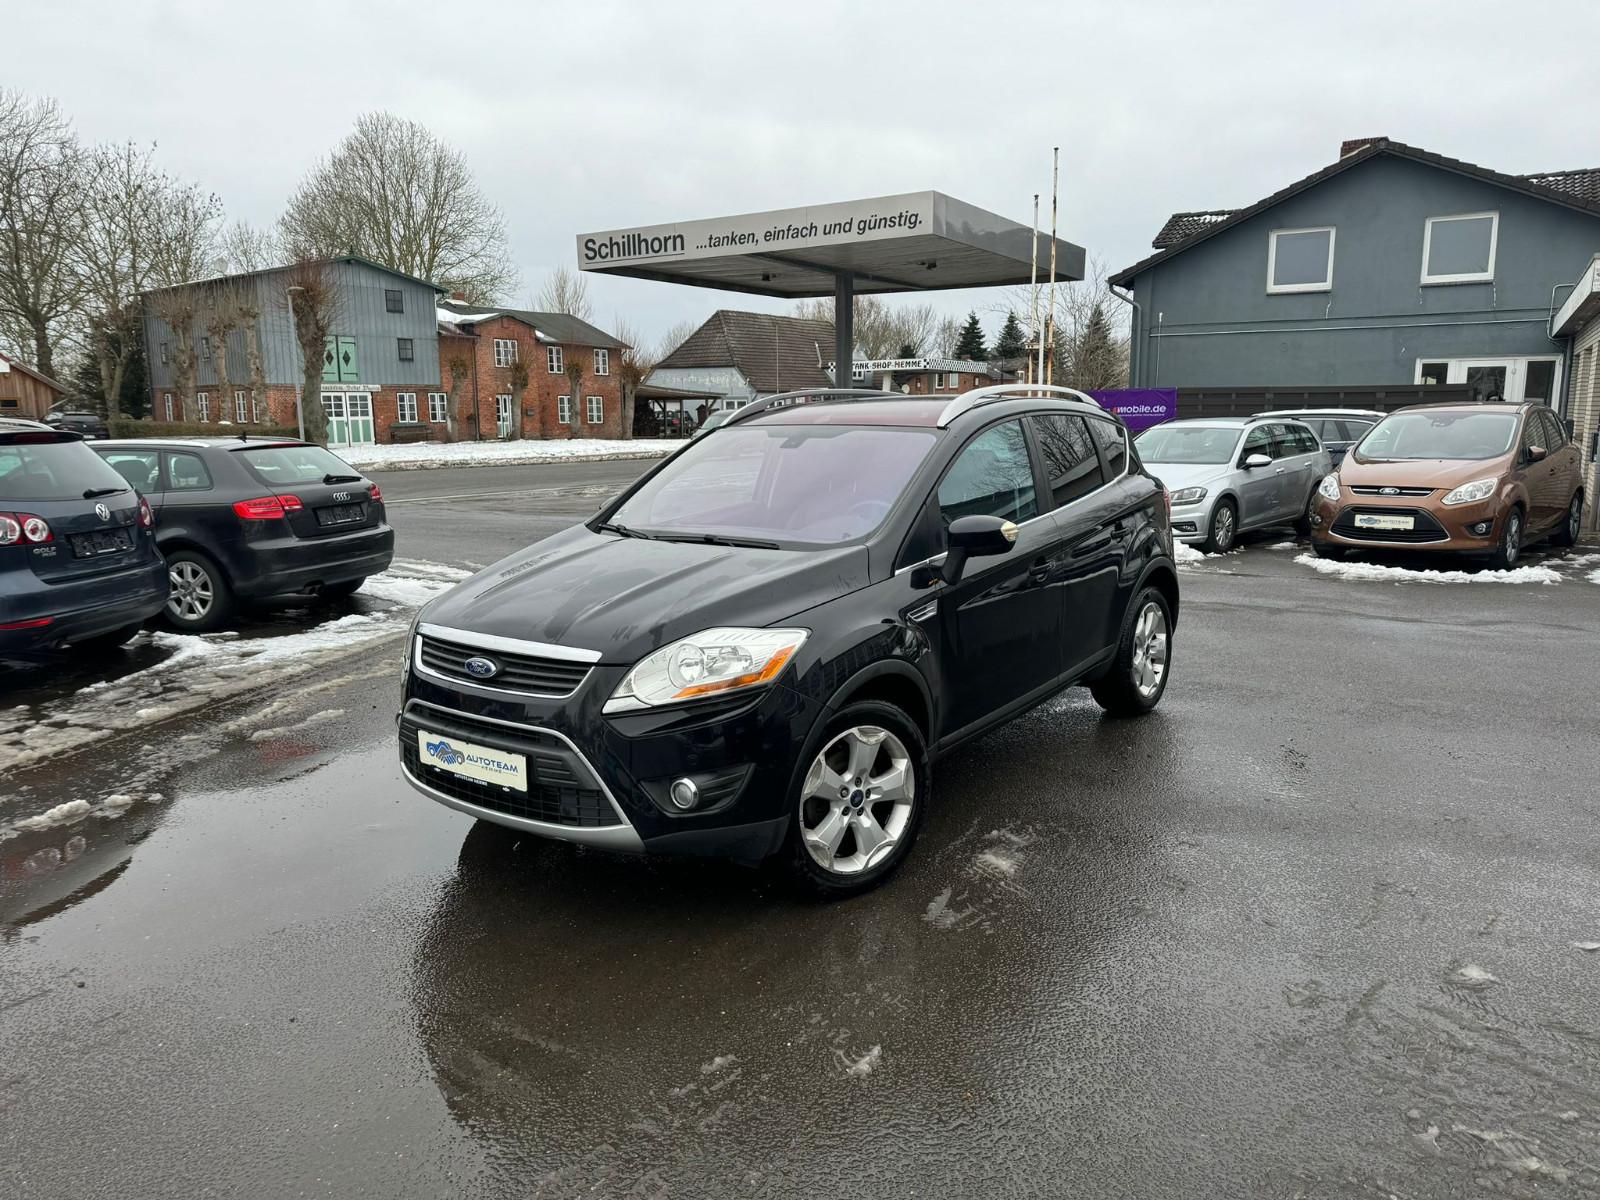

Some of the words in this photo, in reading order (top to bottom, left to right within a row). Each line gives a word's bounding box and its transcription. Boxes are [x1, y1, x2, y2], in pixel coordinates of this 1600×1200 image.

[584, 233, 685, 261] Schillhorn
[696, 231, 759, 250] ...tanken,
[764, 222, 818, 242] einfach
[823, 217, 854, 236] und
[857, 210, 923, 235] günstig.
[466, 754, 518, 773] AUTOTEAM
